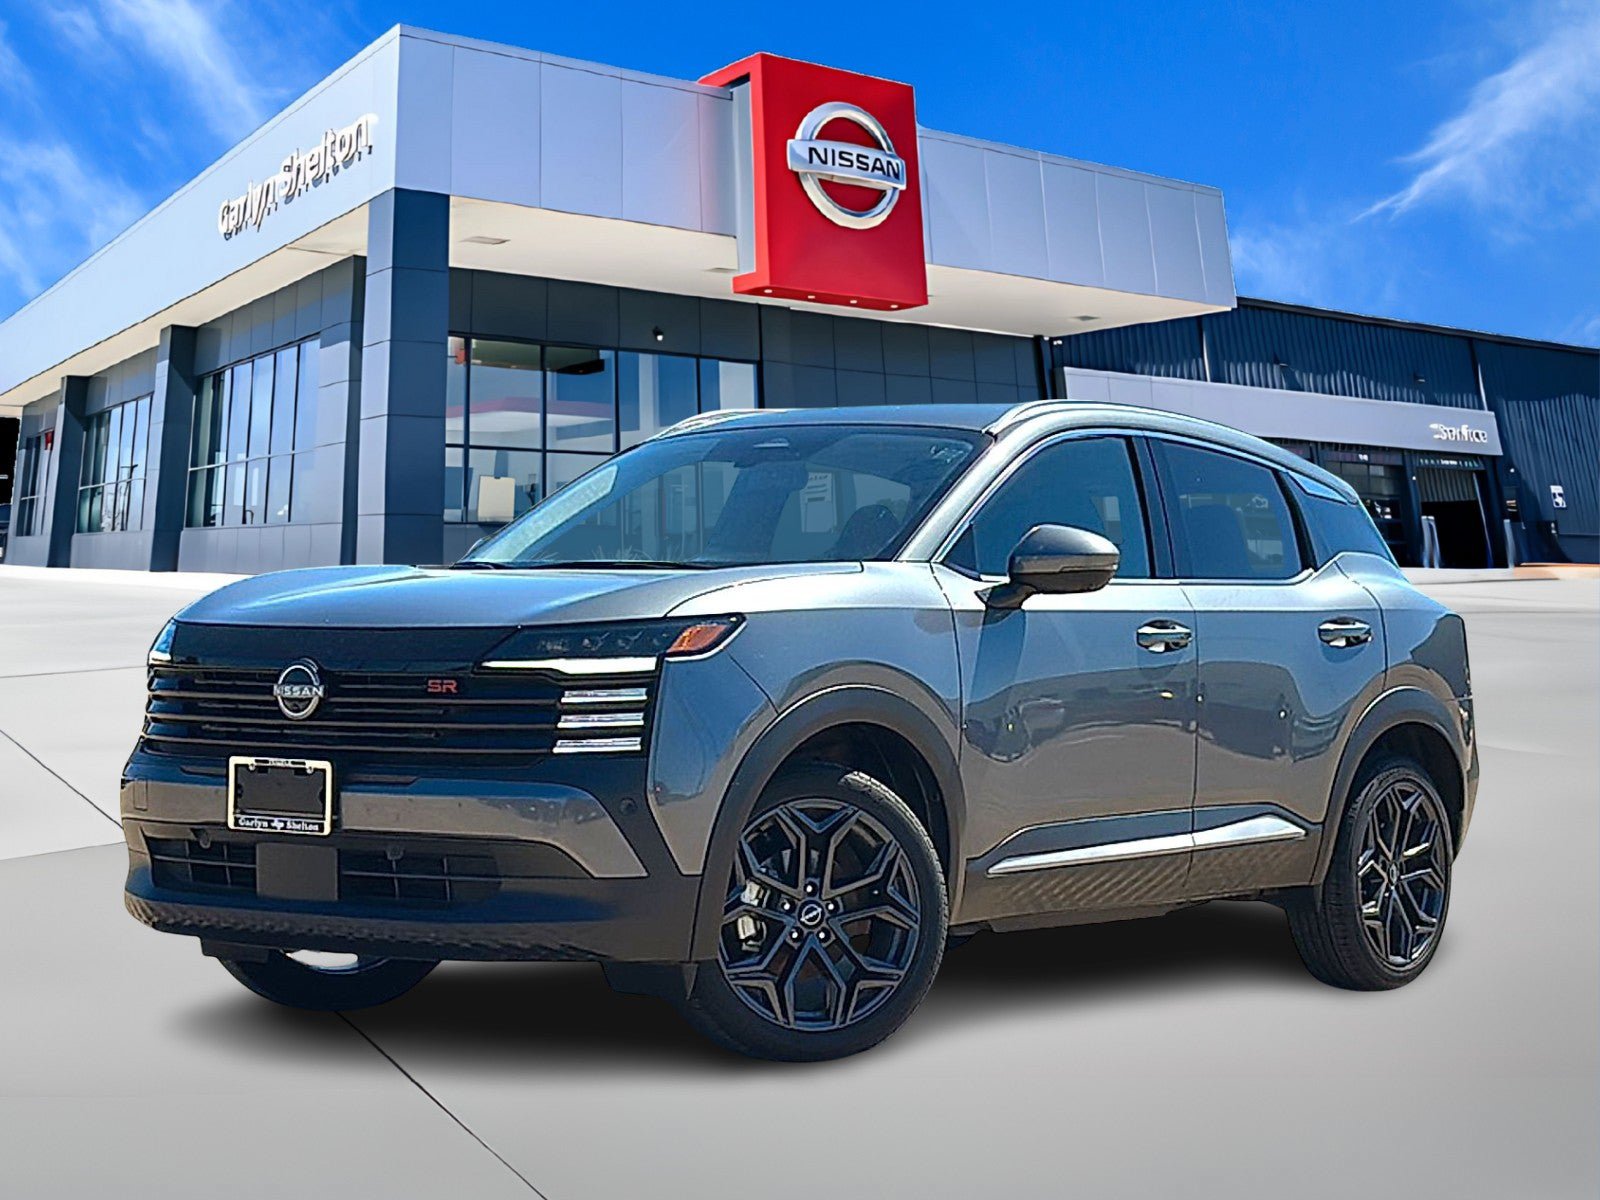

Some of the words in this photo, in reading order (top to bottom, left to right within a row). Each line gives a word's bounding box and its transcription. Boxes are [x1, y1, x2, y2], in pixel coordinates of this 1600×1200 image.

[279, 116, 374, 205] Shelton
[808, 146, 900, 181] NISSAN
[1429, 423, 1488, 443] Service
[273, 684, 324, 698] NISSAN
[427, 679, 458, 693] SR
[286, 820, 319, 832] Shelton
